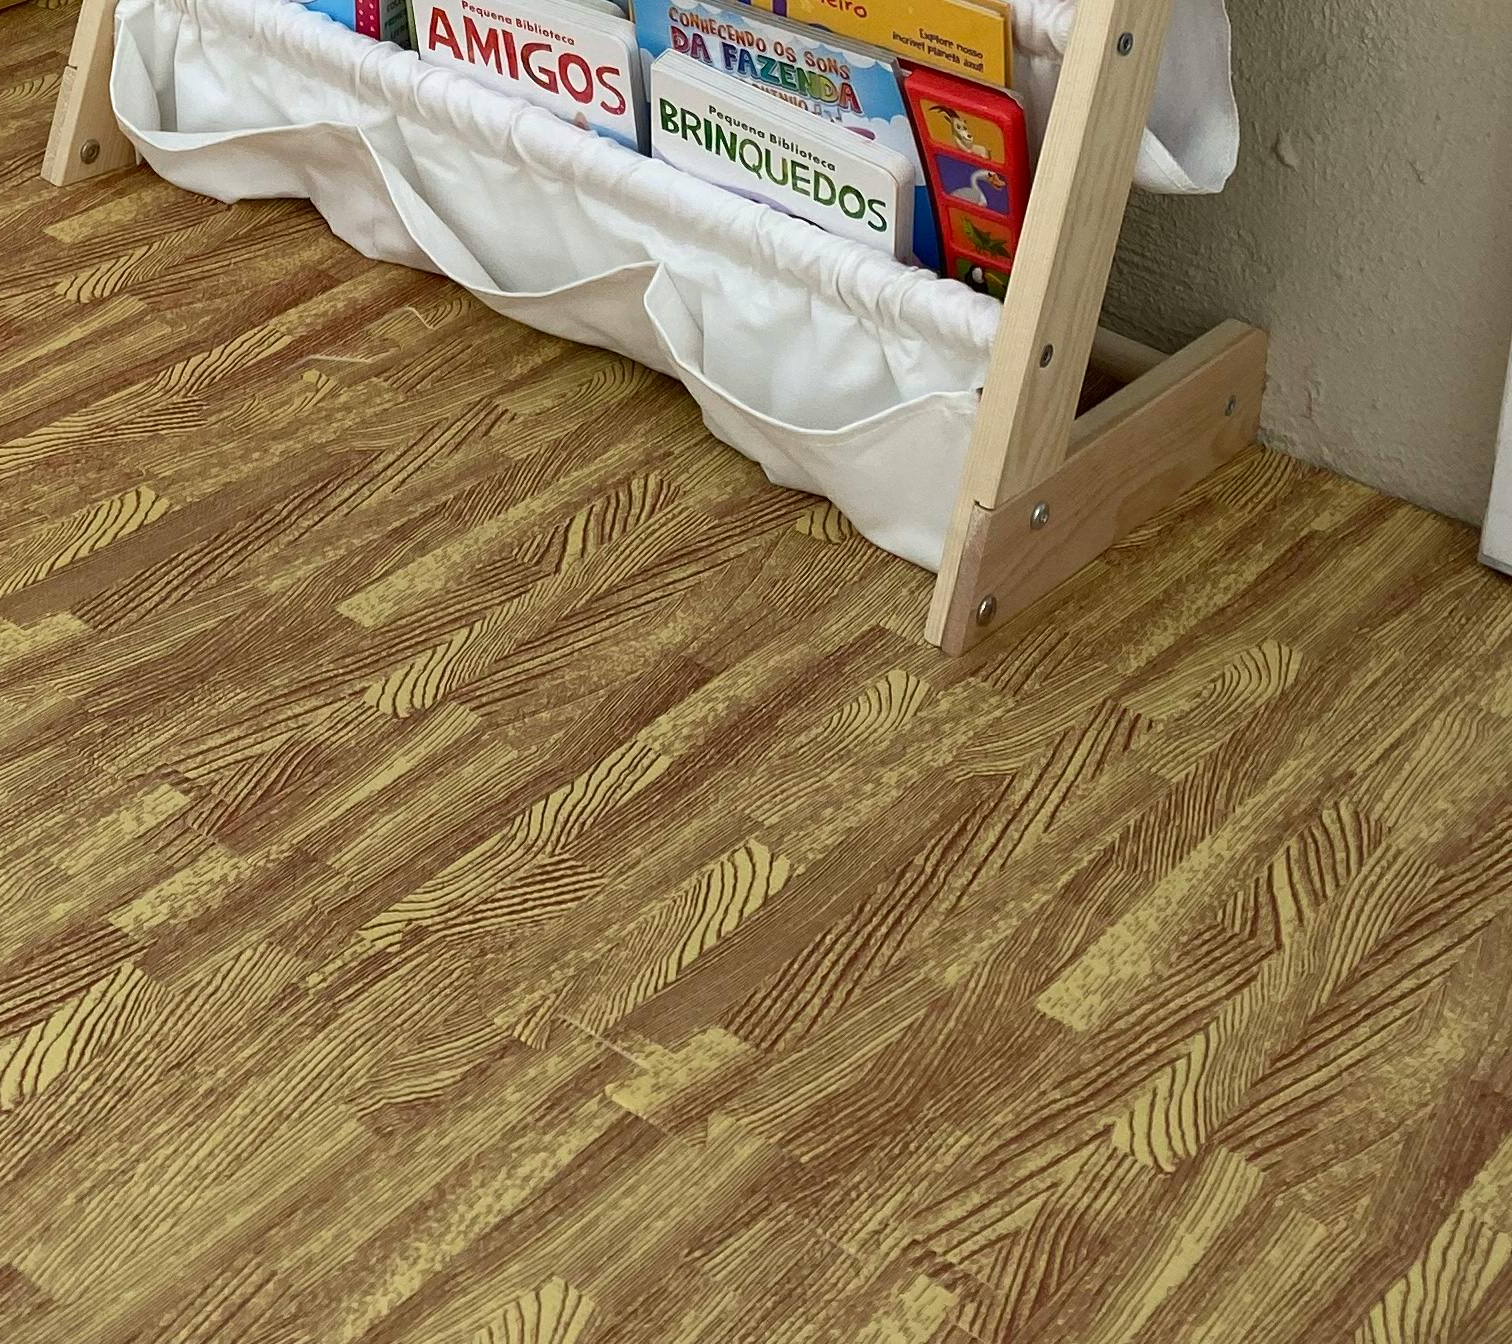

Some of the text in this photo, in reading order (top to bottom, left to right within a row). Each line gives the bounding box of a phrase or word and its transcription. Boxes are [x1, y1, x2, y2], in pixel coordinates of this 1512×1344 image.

[461, 0, 576, 46] Pequena Biblioteca
[668, 6, 850, 81] CONHECENDO OS SONS
[956, 43, 984, 59] nosso
[428, 6, 626, 117] AMIGOS
[670, 25, 713, 63] DA
[721, 42, 864, 114] FAZENDA
[659, 97, 888, 233] BRINQUEDOS
[708, 104, 836, 172] Pequena Biblioteca
